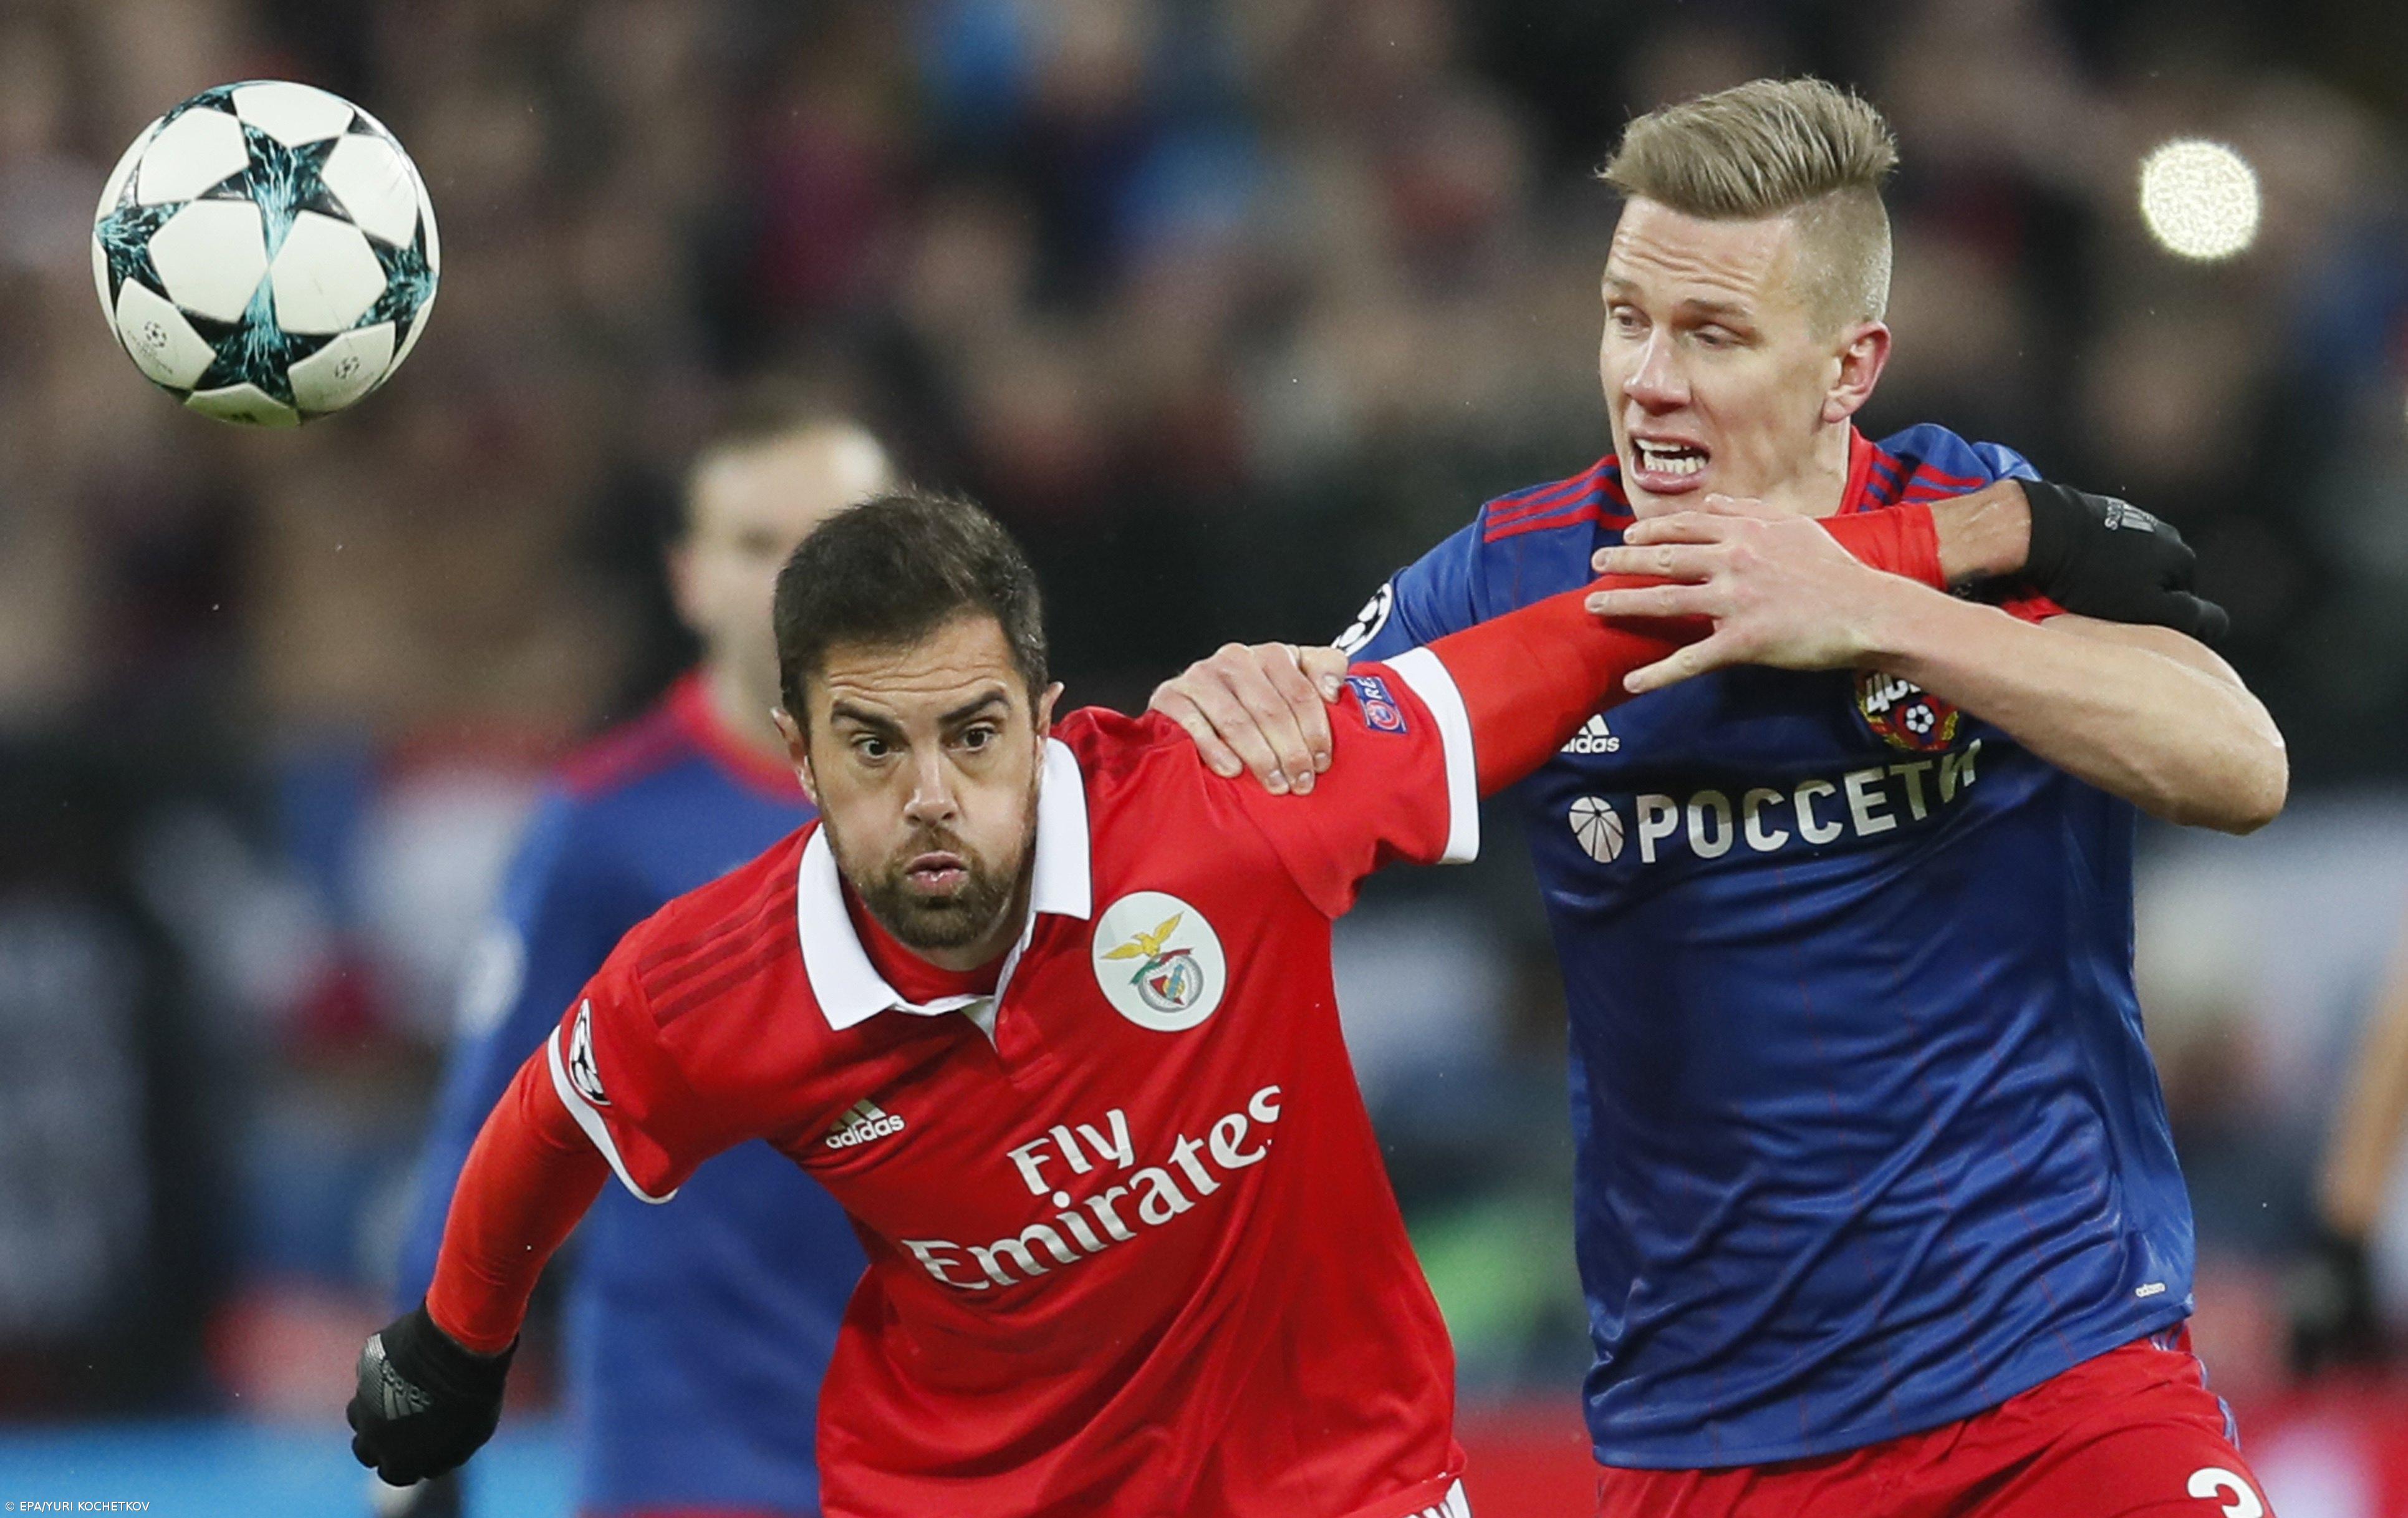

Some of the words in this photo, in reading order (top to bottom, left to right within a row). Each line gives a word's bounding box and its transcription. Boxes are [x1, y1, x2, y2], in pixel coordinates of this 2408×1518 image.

[1635, 738, 1982, 864] РОССЕТИ
[826, 1114, 905, 1149] adidas
[1007, 1109, 1135, 1196] Fly
